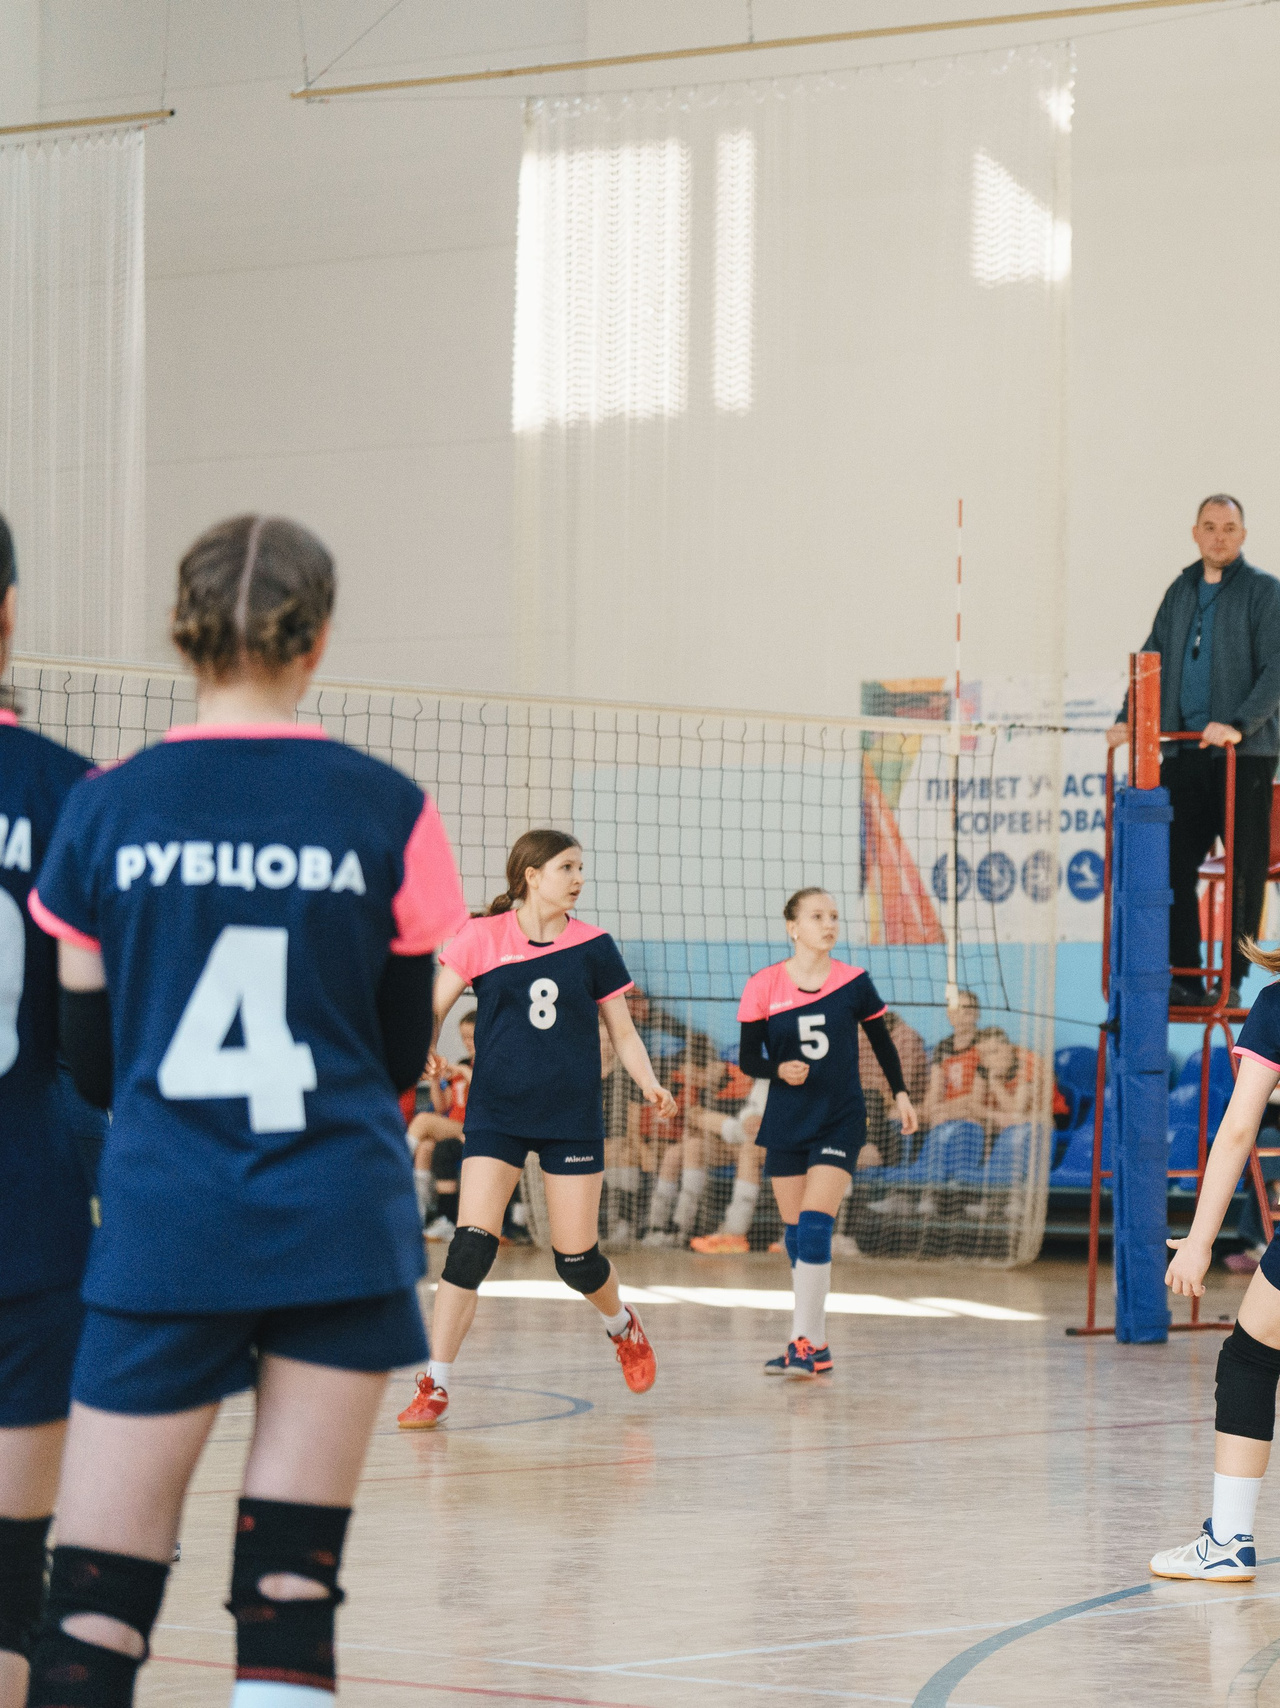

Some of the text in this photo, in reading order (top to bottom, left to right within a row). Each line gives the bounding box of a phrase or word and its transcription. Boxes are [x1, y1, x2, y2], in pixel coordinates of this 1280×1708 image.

[116, 840, 366, 896] РУБЦОВА
[157, 924, 318, 1134] 4
[529, 977, 559, 1030] 8
[798, 1014, 830, 1060] 5
